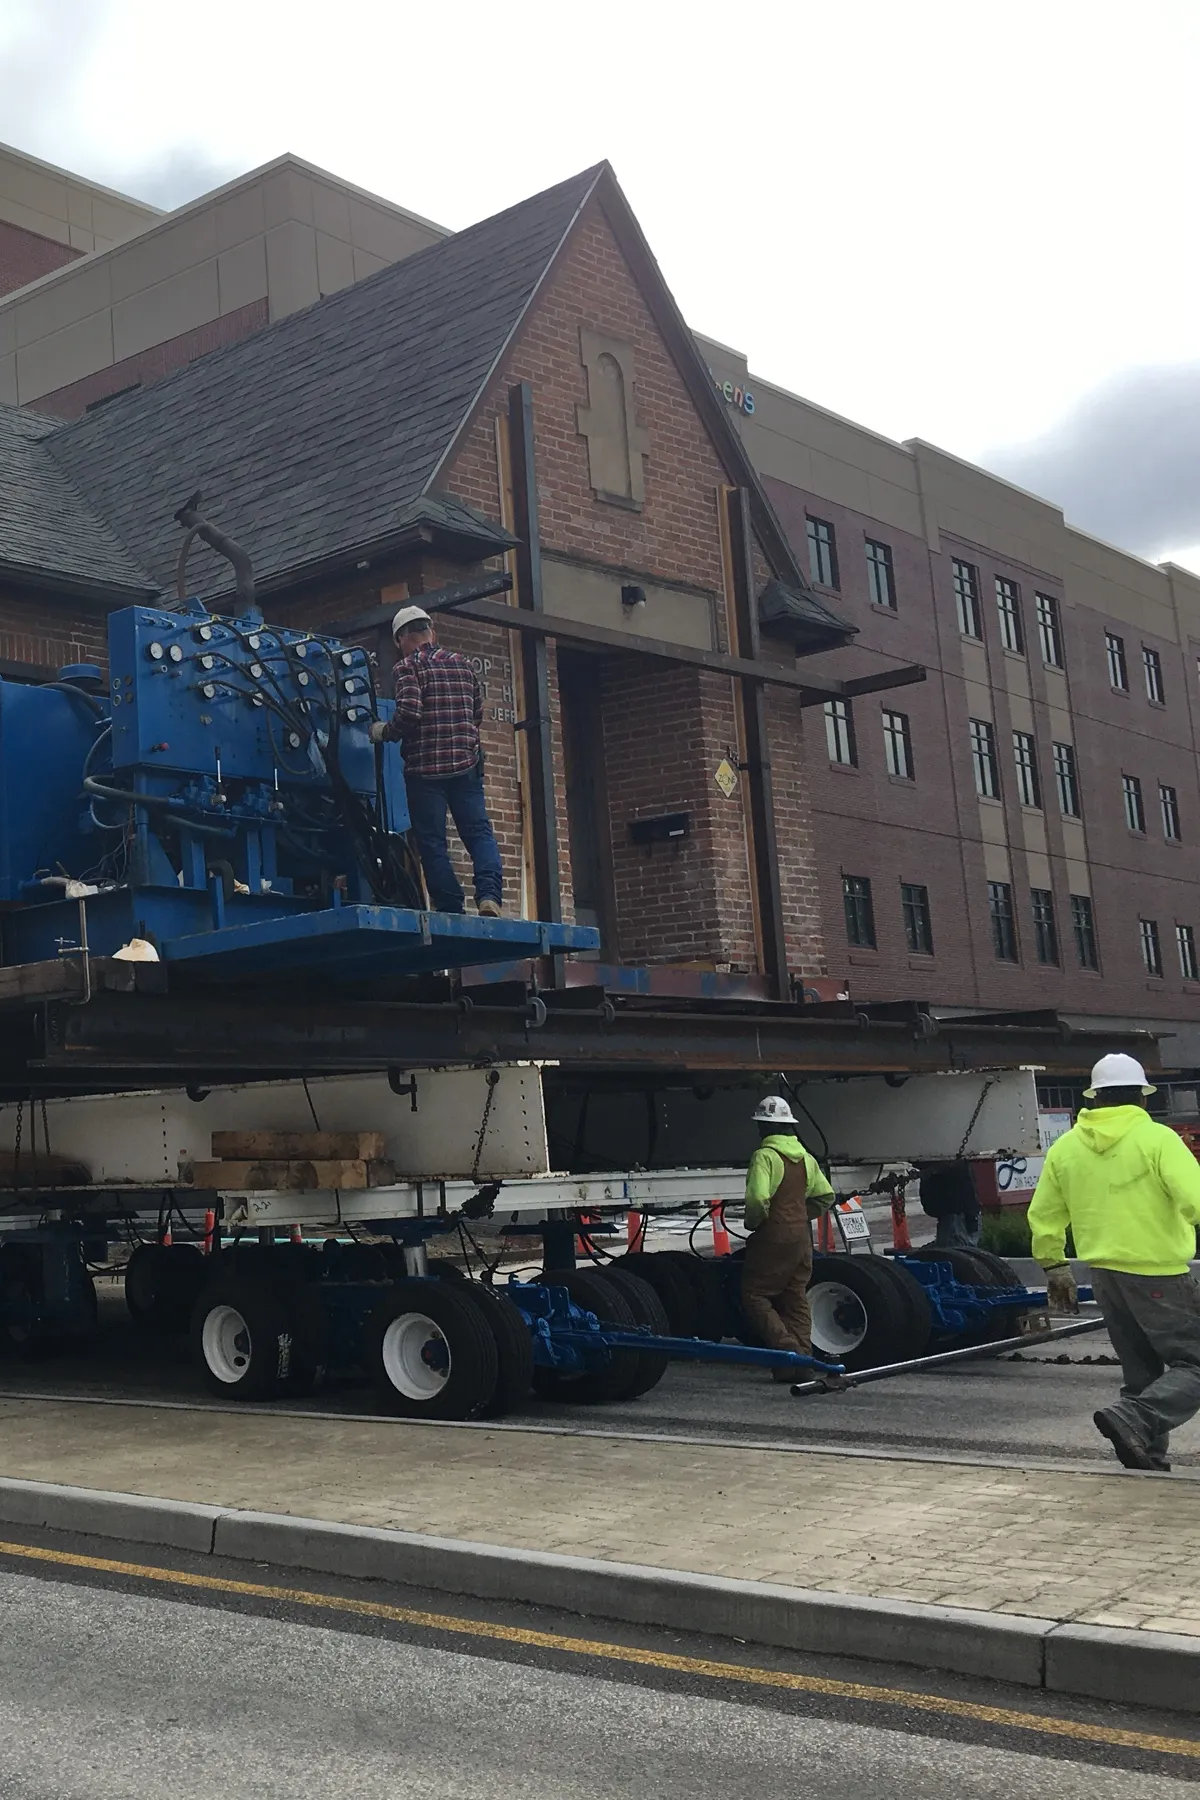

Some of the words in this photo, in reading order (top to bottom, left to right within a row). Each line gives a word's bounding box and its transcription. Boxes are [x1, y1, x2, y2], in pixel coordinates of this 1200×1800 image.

[471, 657, 492, 675] OP
[717, 774, 736, 786] ZONE
[841, 1216, 865, 1227] SIDEWALK
[846, 1223, 865, 1234] CLOSED
